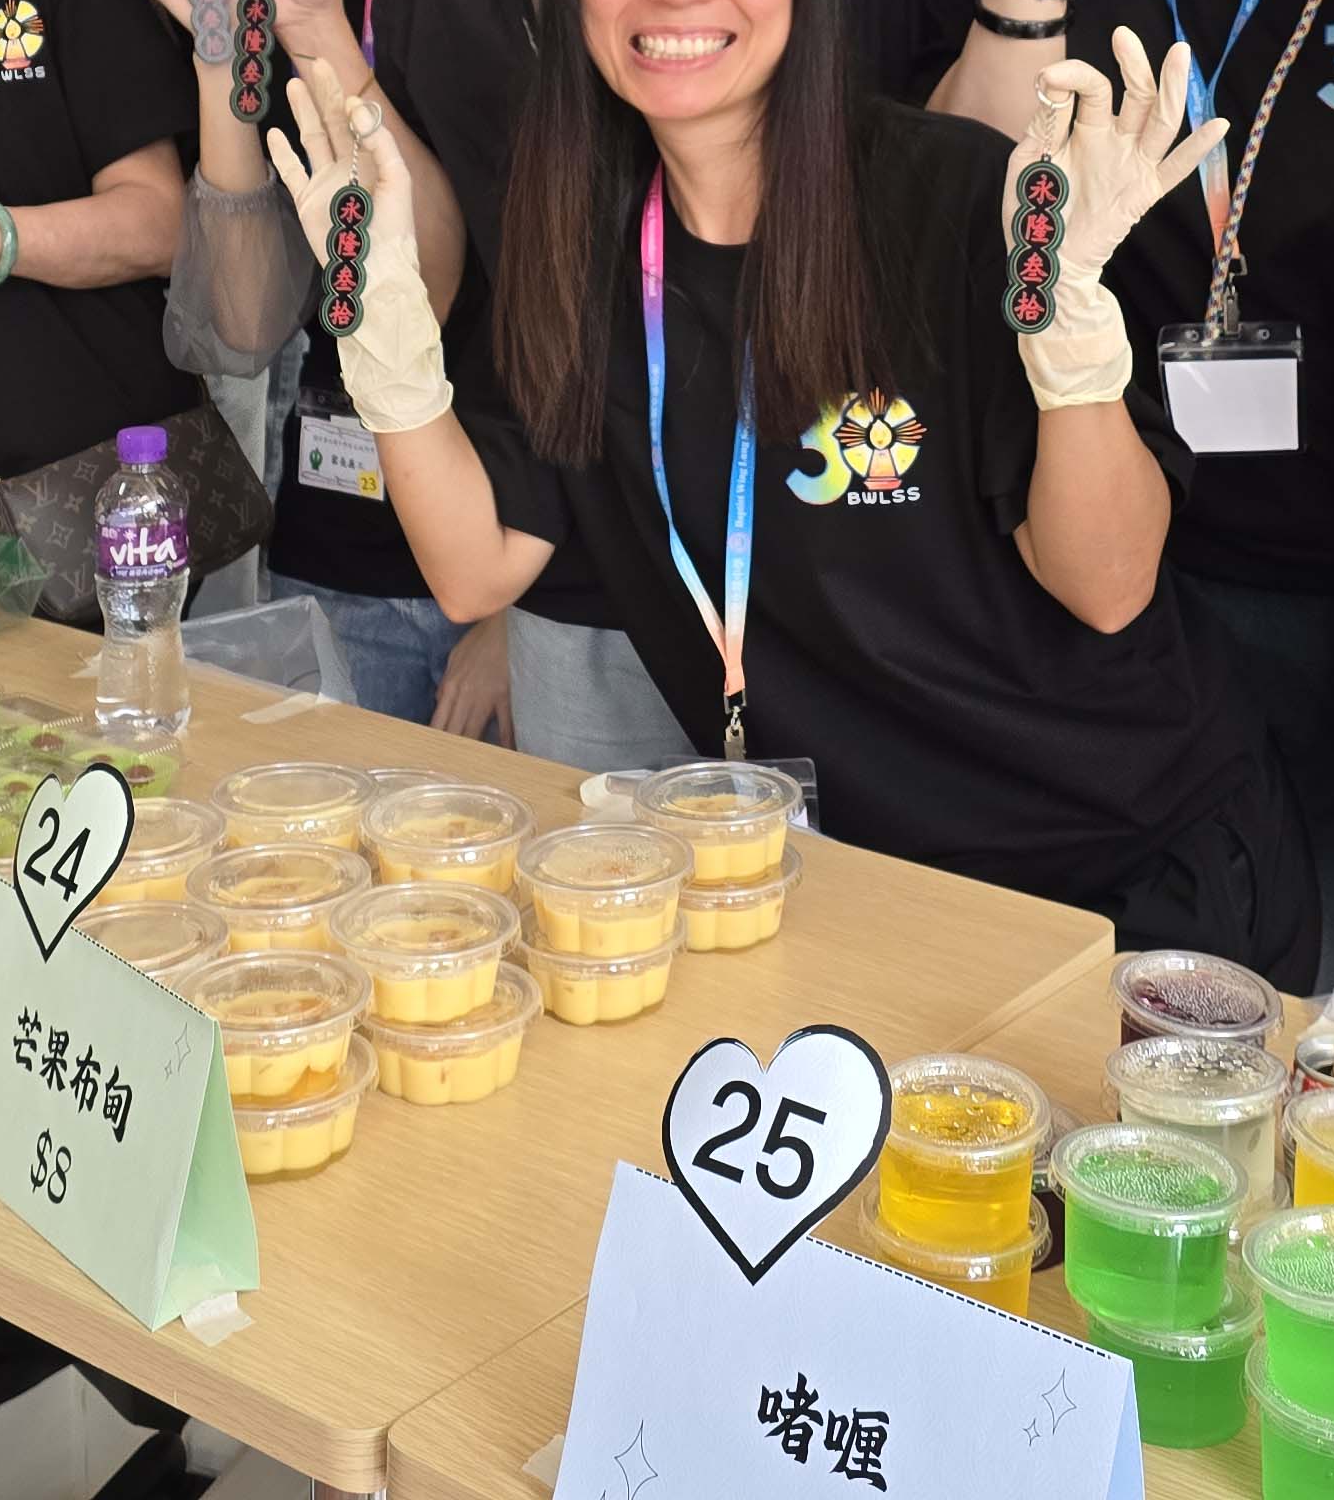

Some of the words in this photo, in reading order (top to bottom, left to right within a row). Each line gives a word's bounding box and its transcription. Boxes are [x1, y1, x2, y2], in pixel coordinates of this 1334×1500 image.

[330, 198, 362, 325] 永隆叁拾
[1016, 172, 1056, 322] 永隆叁拾
[360, 477, 377, 492] 23
[846, 486, 922, 506] BWLSS
[110, 527, 177, 566] vita
[23, 807, 92, 903] 24
[13, 1005, 134, 1144] 芒果布甸
[30, 1128, 73, 1205] $8
[691, 1079, 828, 1201] 25
[756, 1371, 891, 1493] 啫喱
